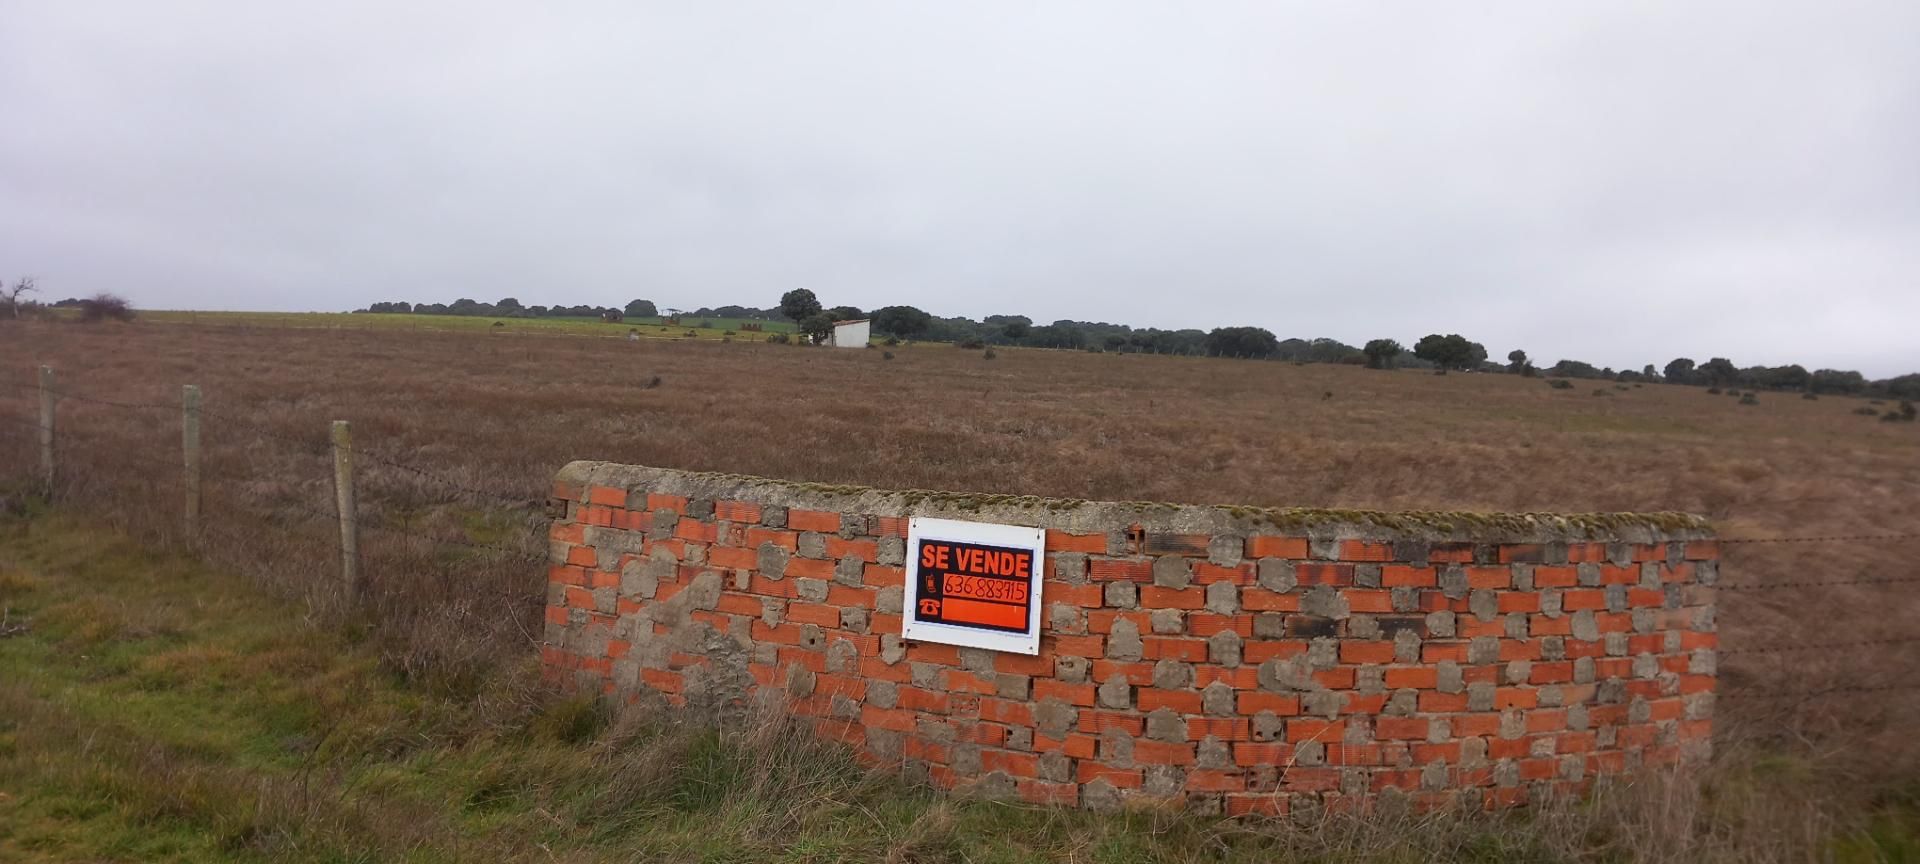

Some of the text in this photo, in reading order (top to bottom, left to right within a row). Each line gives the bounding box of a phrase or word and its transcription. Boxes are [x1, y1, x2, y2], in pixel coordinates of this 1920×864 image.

[922, 544, 1029, 577] SE VENDE
[945, 575, 973, 594] 636
